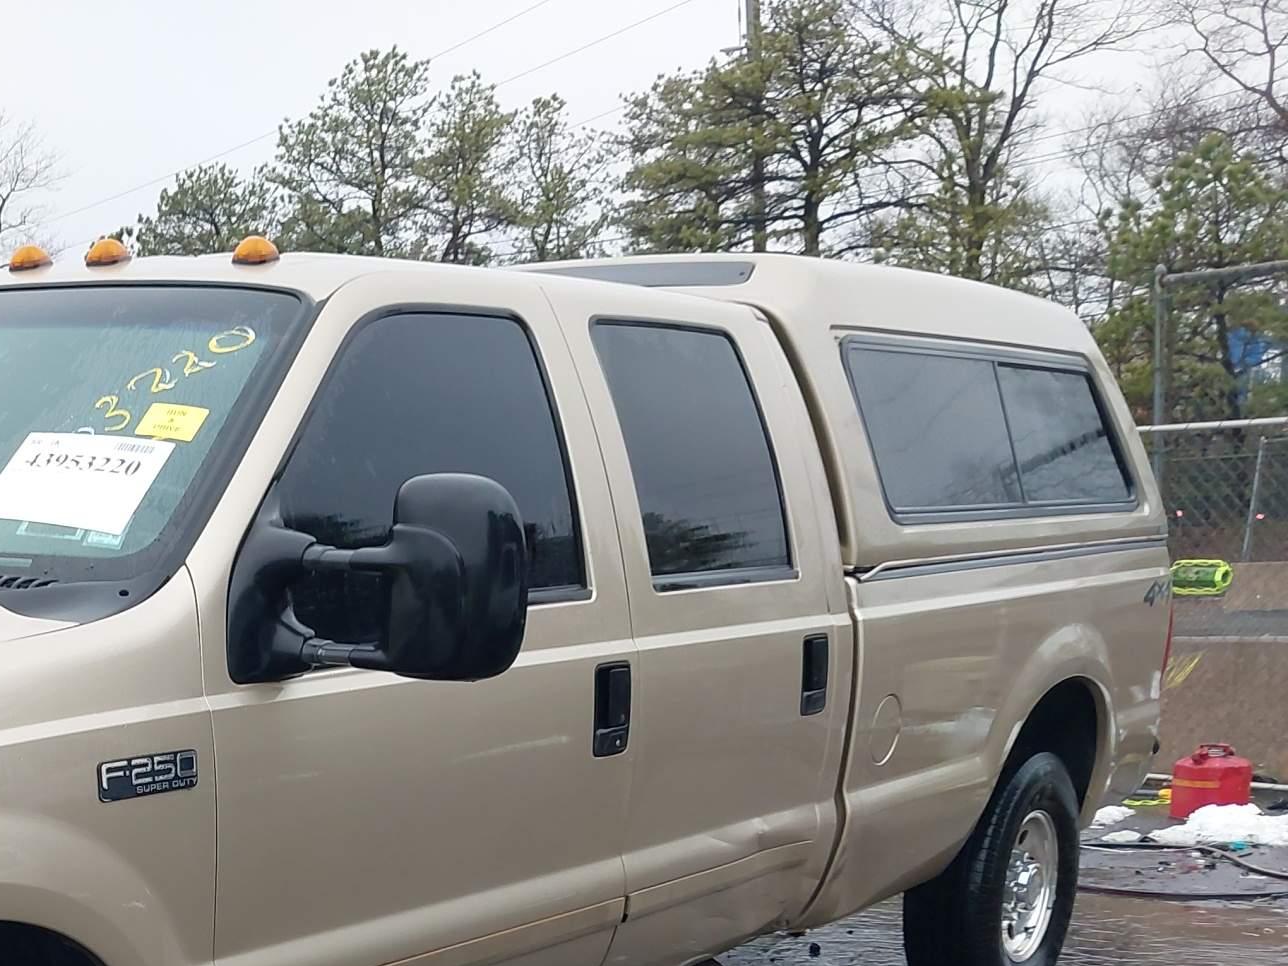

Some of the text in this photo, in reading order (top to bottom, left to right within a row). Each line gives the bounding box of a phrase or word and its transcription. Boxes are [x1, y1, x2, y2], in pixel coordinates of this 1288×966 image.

[76, 326, 256, 434] 3220
[25, 452, 141, 476] 43953220
[136, 777, 198, 794] SUPER DUTY
